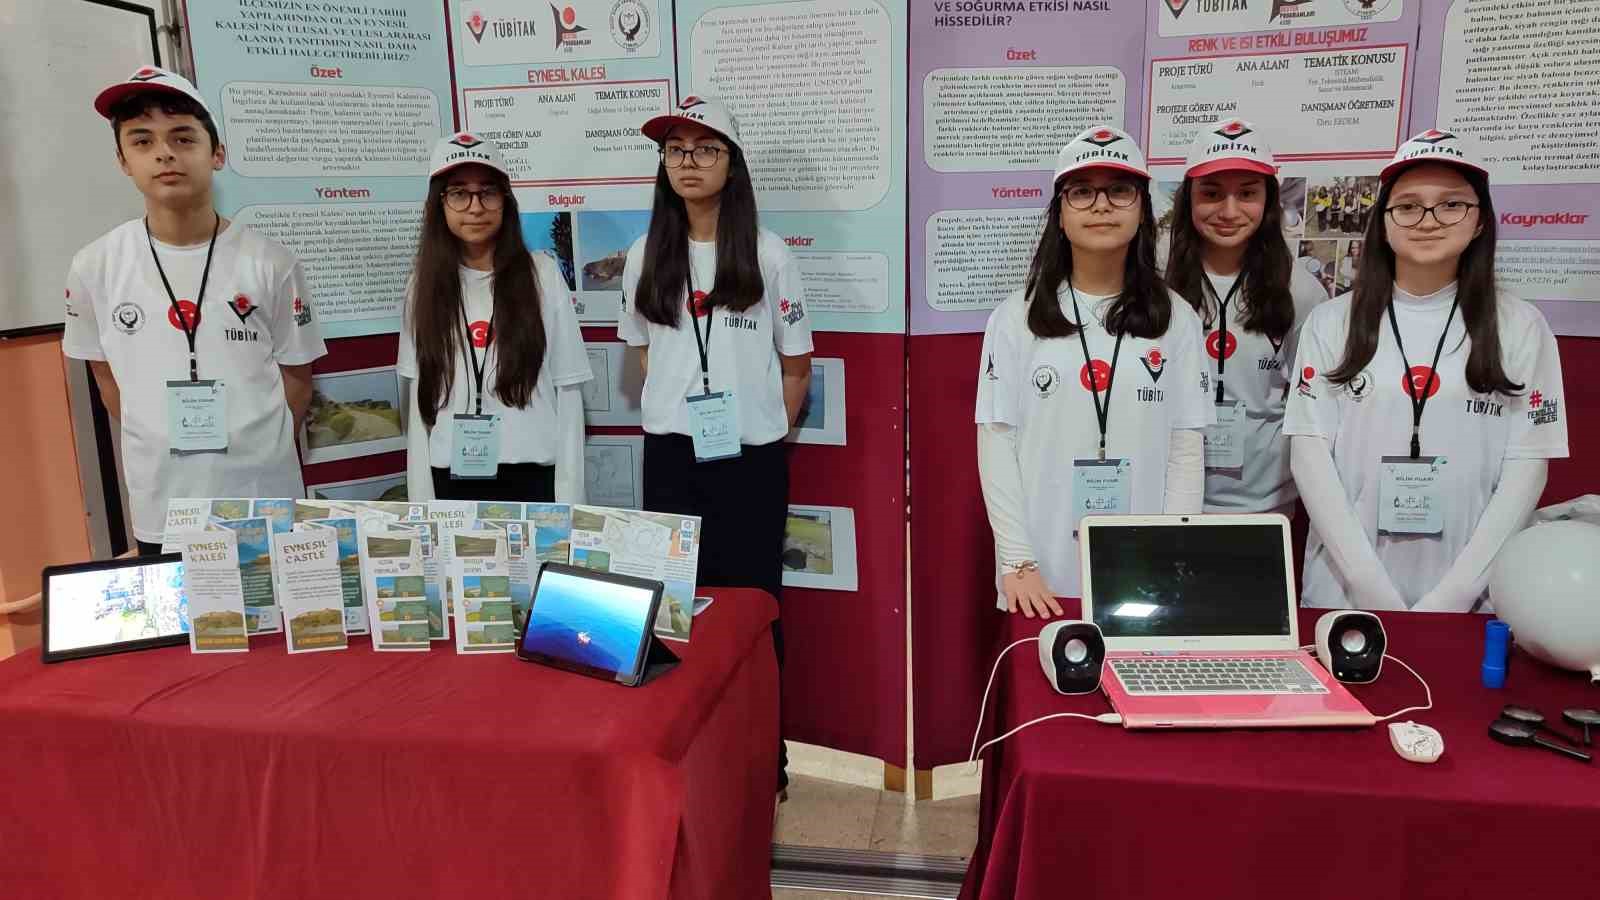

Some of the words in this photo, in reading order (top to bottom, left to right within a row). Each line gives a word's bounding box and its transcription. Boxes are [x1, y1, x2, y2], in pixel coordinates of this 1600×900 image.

[934, 0, 951, 12] VE
[956, 0, 1025, 13] SOĞURMA
[1029, 0, 1069, 12] ETKİSİ
[1073, 0, 1111, 11] NASIL
[934, 14, 1013, 27] HİSSEDİLİR?
[334, 28, 347, 36] VE
[493, 18, 536, 38] TÜBİTAK
[236, 34, 284, 45] ALANDA
[387, 42, 416, 50] DAHA
[1188, 39, 1218, 52] RENK
[1222, 38, 1236, 50] VE
[1256, 34, 1291, 48] ETKİLİ
[1295, 28, 1368, 46] BULUŞUMUZ
[1006, 47, 1037, 61] Özet
[1303, 55, 1349, 69] TEMATİK
[1351, 52, 1396, 65] KONUSU
[310, 64, 344, 79] Özet
[1159, 65, 1186, 77] PROJE
[1188, 63, 1213, 75] TÜRÜ
[1236, 60, 1257, 72] ANA
[1261, 59, 1289, 71] ALANI
[528, 65, 570, 83] EYNESİL
[572, 64, 606, 82] KALESİ
[595, 90, 627, 101] TEMATİK
[629, 88, 661, 99] KONUSU
[1157, 103, 1187, 115] PROJEDE
[1188, 102, 1216, 112] GÖREV
[1217, 102, 1237, 111] ALAN
[1301, 102, 1346, 113] DANIŞMAN
[1348, 99, 1395, 111] ÖĞRETMEN
[525, 129, 542, 138] ALAN
[315, 187, 370, 199] Yöntem
[992, 188, 1042, 198] Yöntem
[549, 194, 586, 208] Bulgular
[1500, 212, 1589, 227] Kaynaklar
[724, 315, 758, 330] TÜBİTAK
[285, 551, 325, 564] CASTLE
